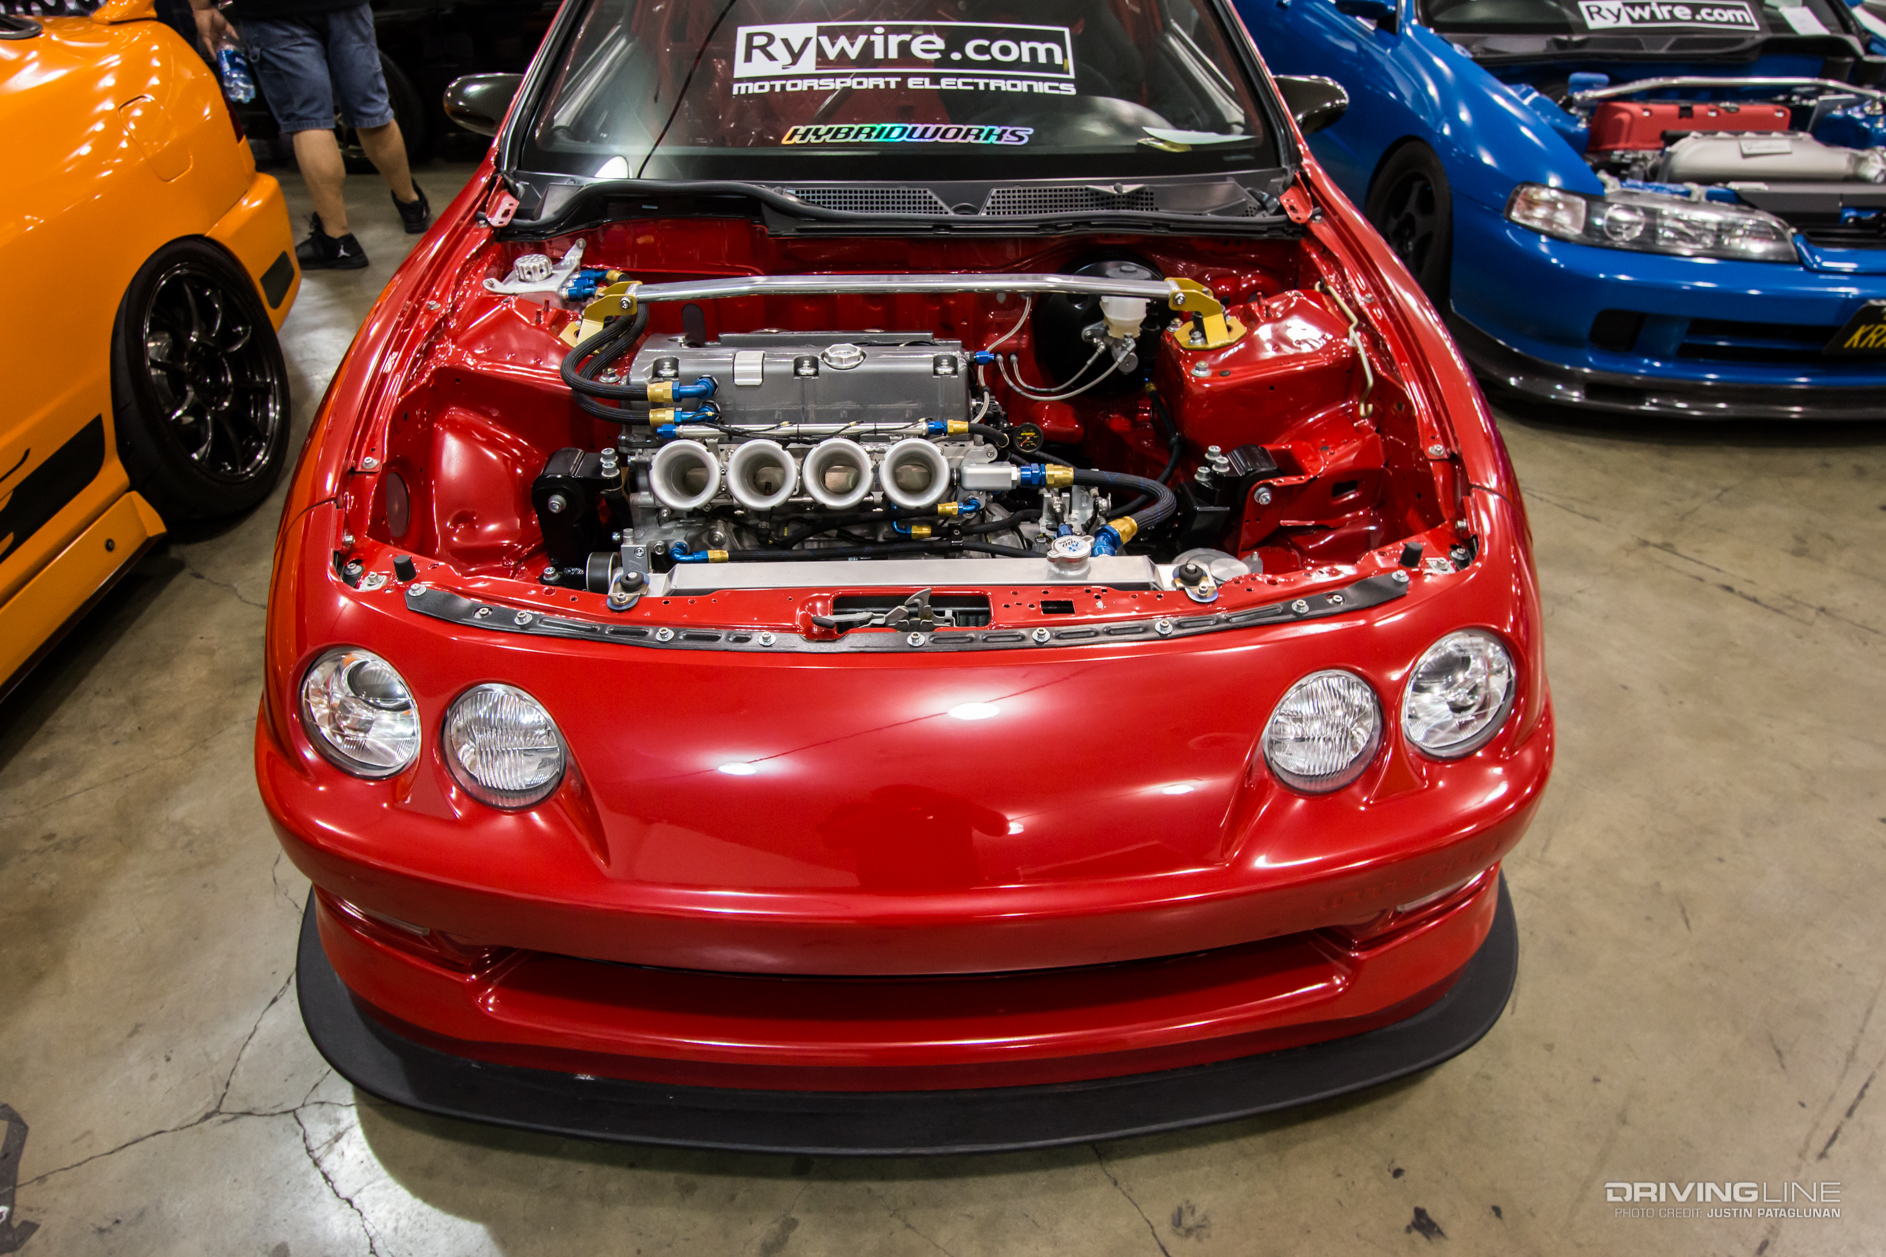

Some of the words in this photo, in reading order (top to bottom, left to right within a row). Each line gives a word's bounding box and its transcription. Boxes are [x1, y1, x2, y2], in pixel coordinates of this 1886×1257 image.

[1588, 2, 1751, 23] Rywire.com
[744, 26, 1064, 70] Rywire.com
[732, 77, 901, 95] MOTORSPORT
[907, 77, 1076, 95] ELECTRONICS
[781, 123, 1034, 145] HYBRIDWORKS
